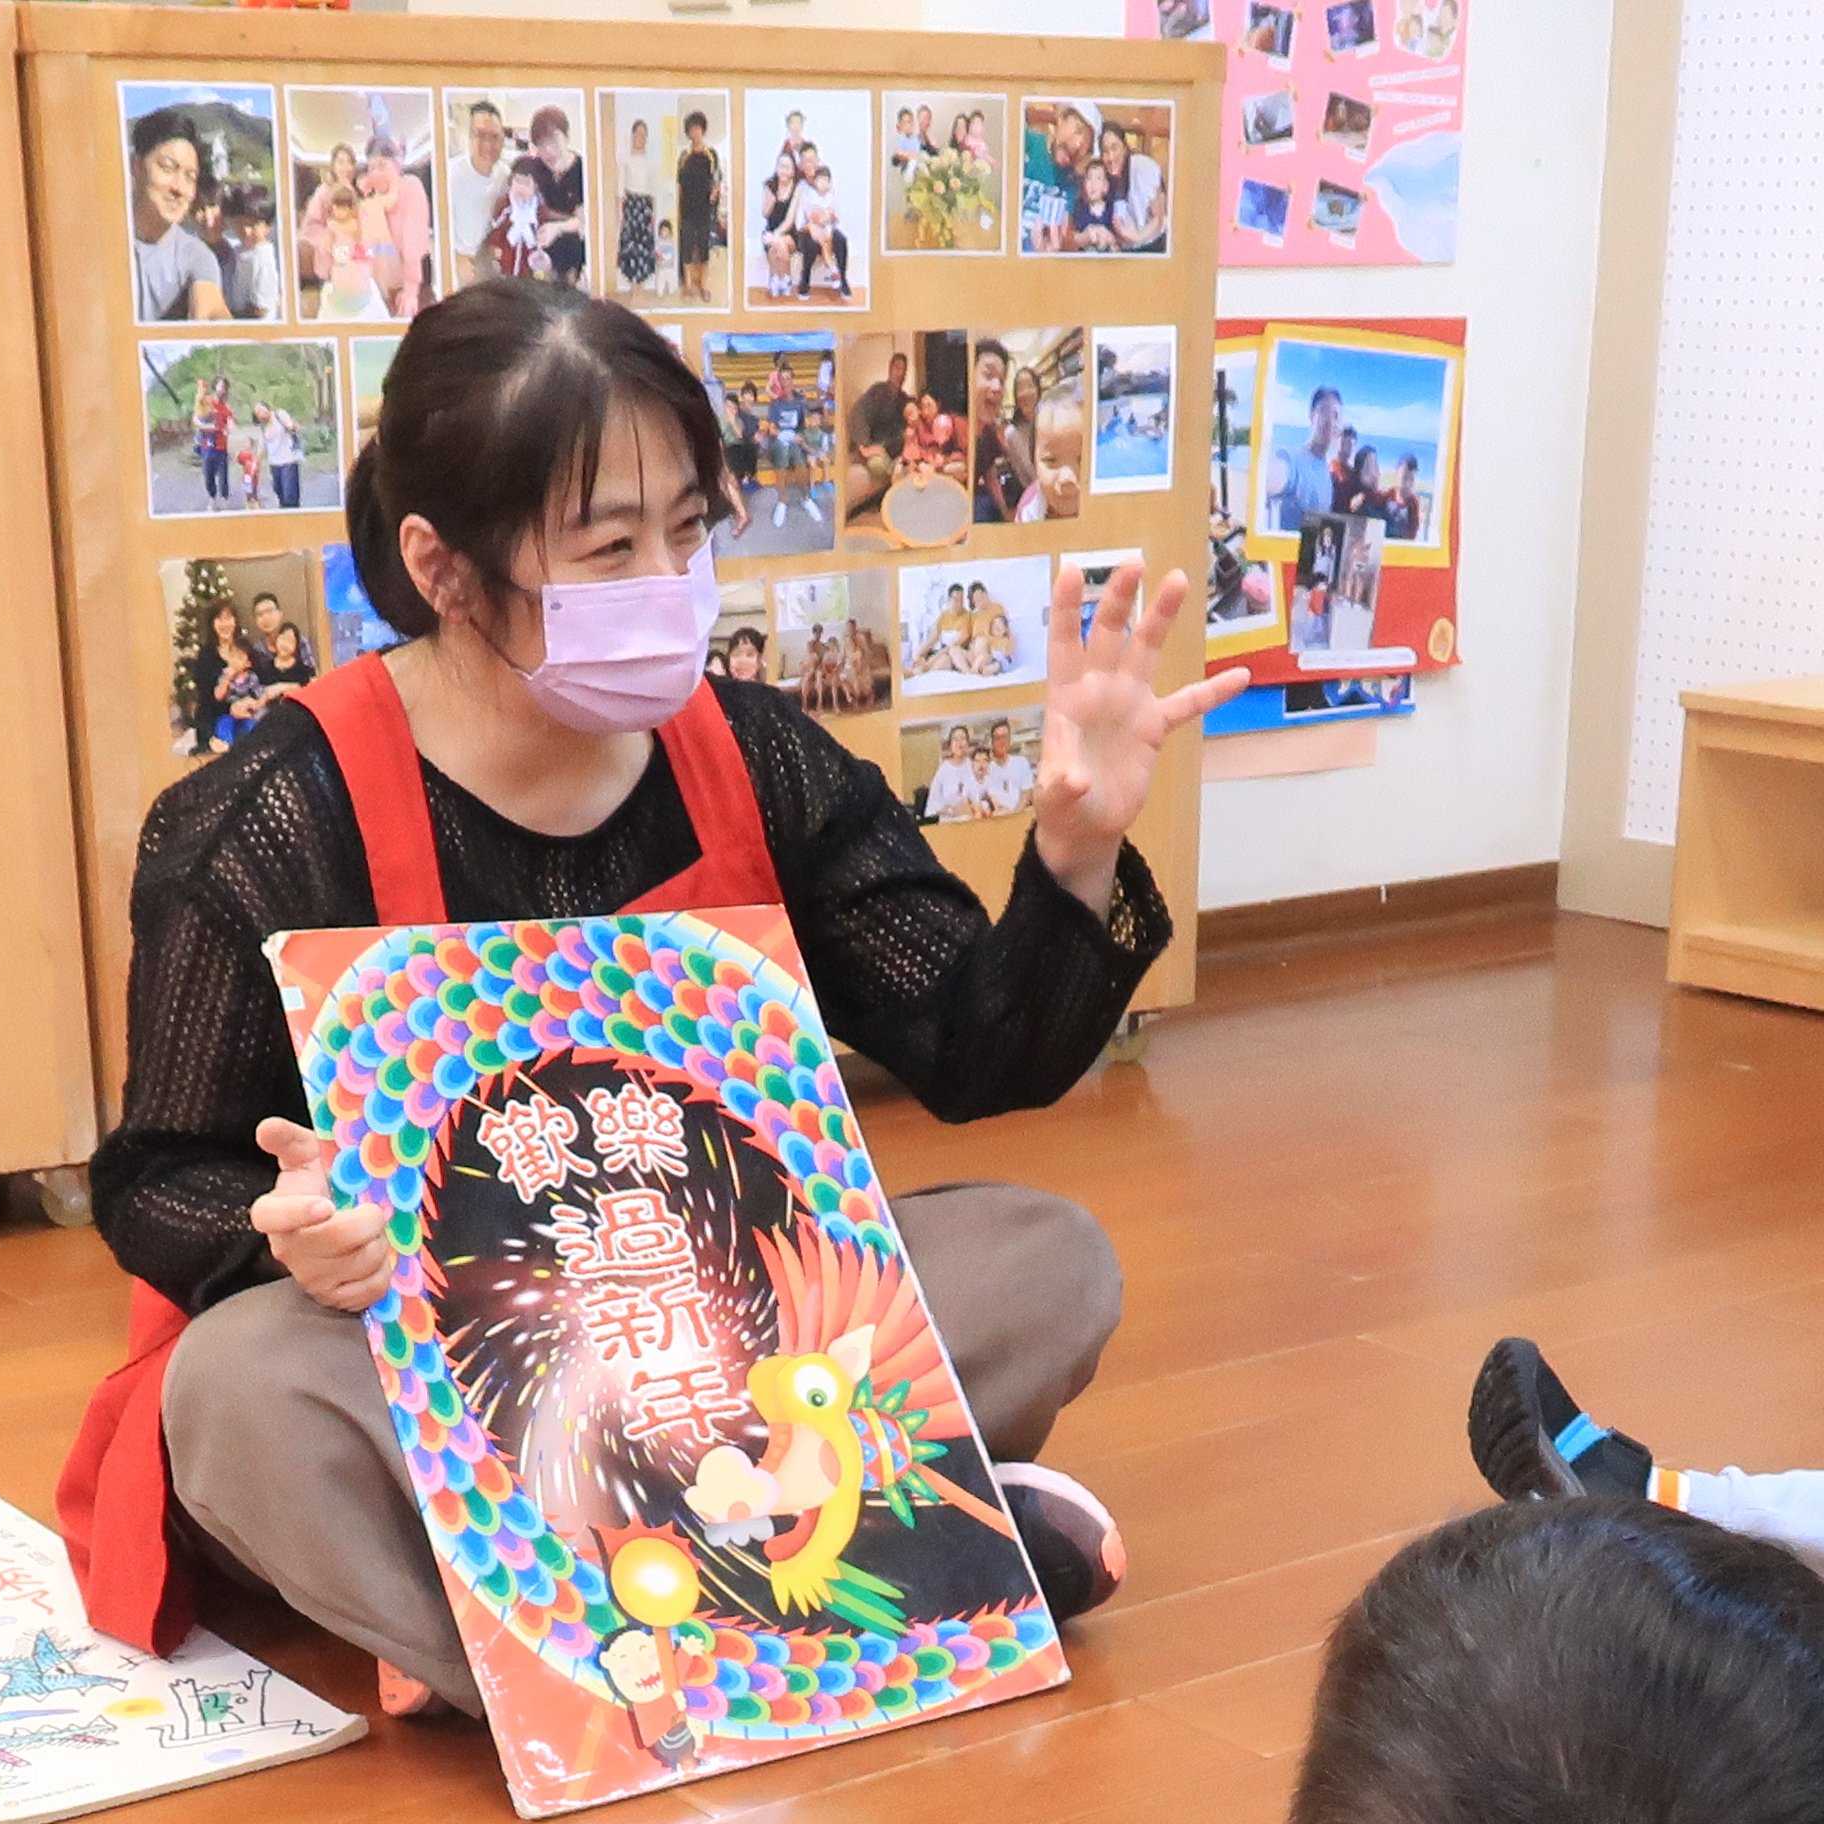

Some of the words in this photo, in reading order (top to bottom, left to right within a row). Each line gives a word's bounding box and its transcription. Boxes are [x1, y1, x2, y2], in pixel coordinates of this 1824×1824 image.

[477, 1083, 689, 1204] 歡樂
[549, 1187, 751, 1444] 過新年
